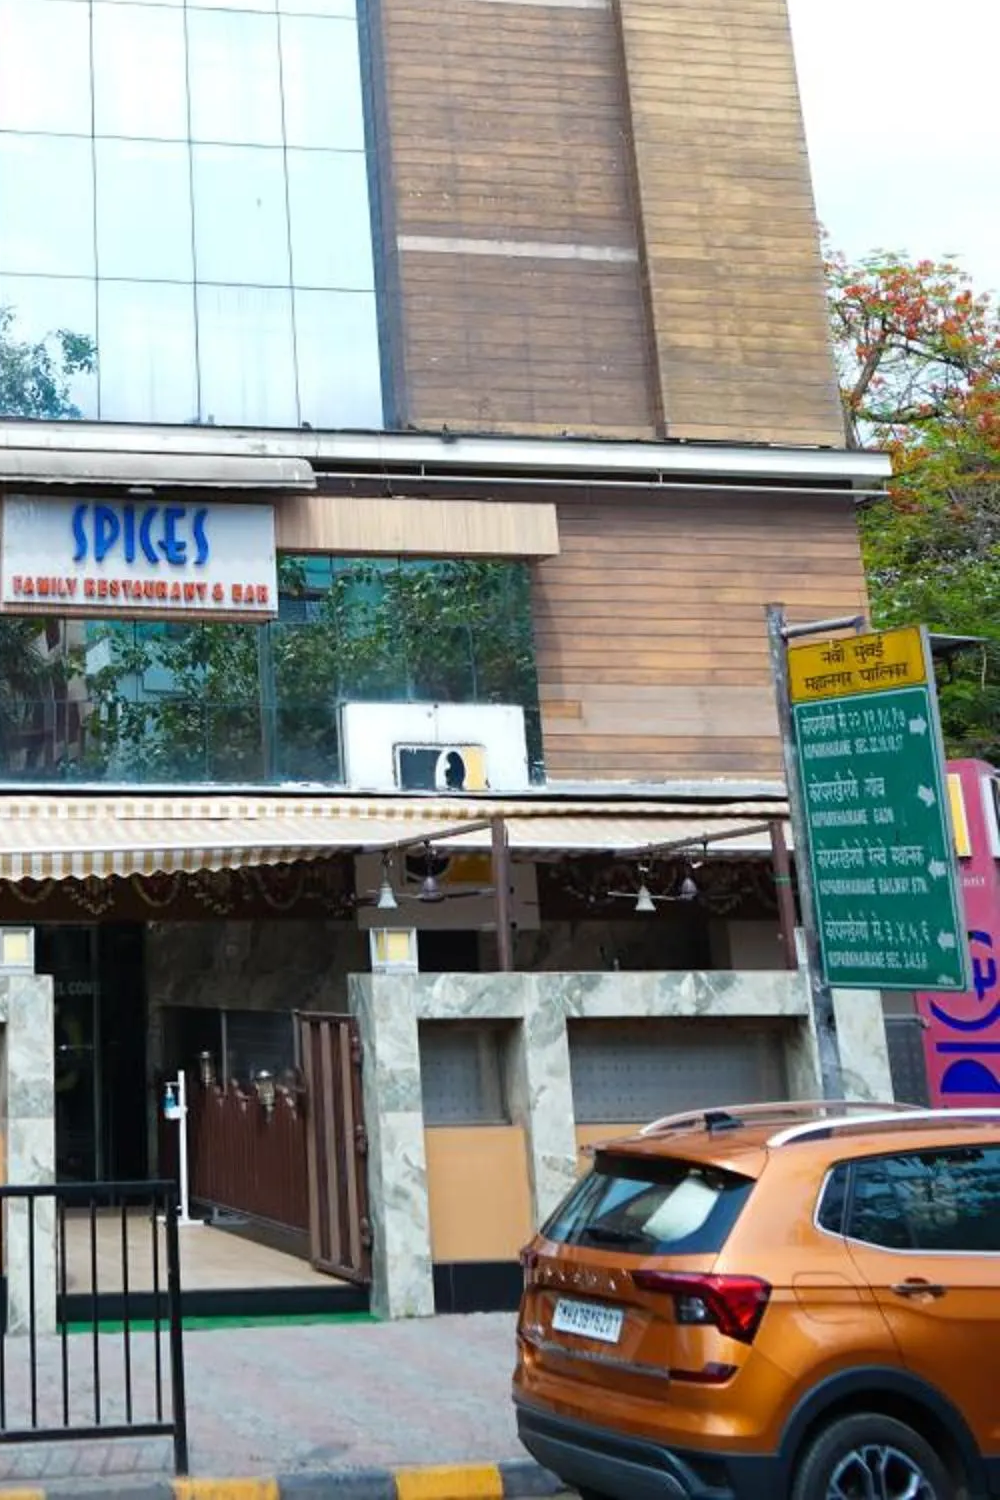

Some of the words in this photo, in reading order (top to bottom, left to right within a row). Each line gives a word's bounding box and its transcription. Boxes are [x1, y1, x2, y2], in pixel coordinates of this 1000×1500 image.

[72, 503, 210, 565] SPICES
[12, 575, 78, 598] FAMILY
[83, 577, 207, 601] RESTAURANT
[230, 584, 270, 604] BAR
[820, 642, 845, 665] नवी
[853, 637, 885, 663] मुंबई
